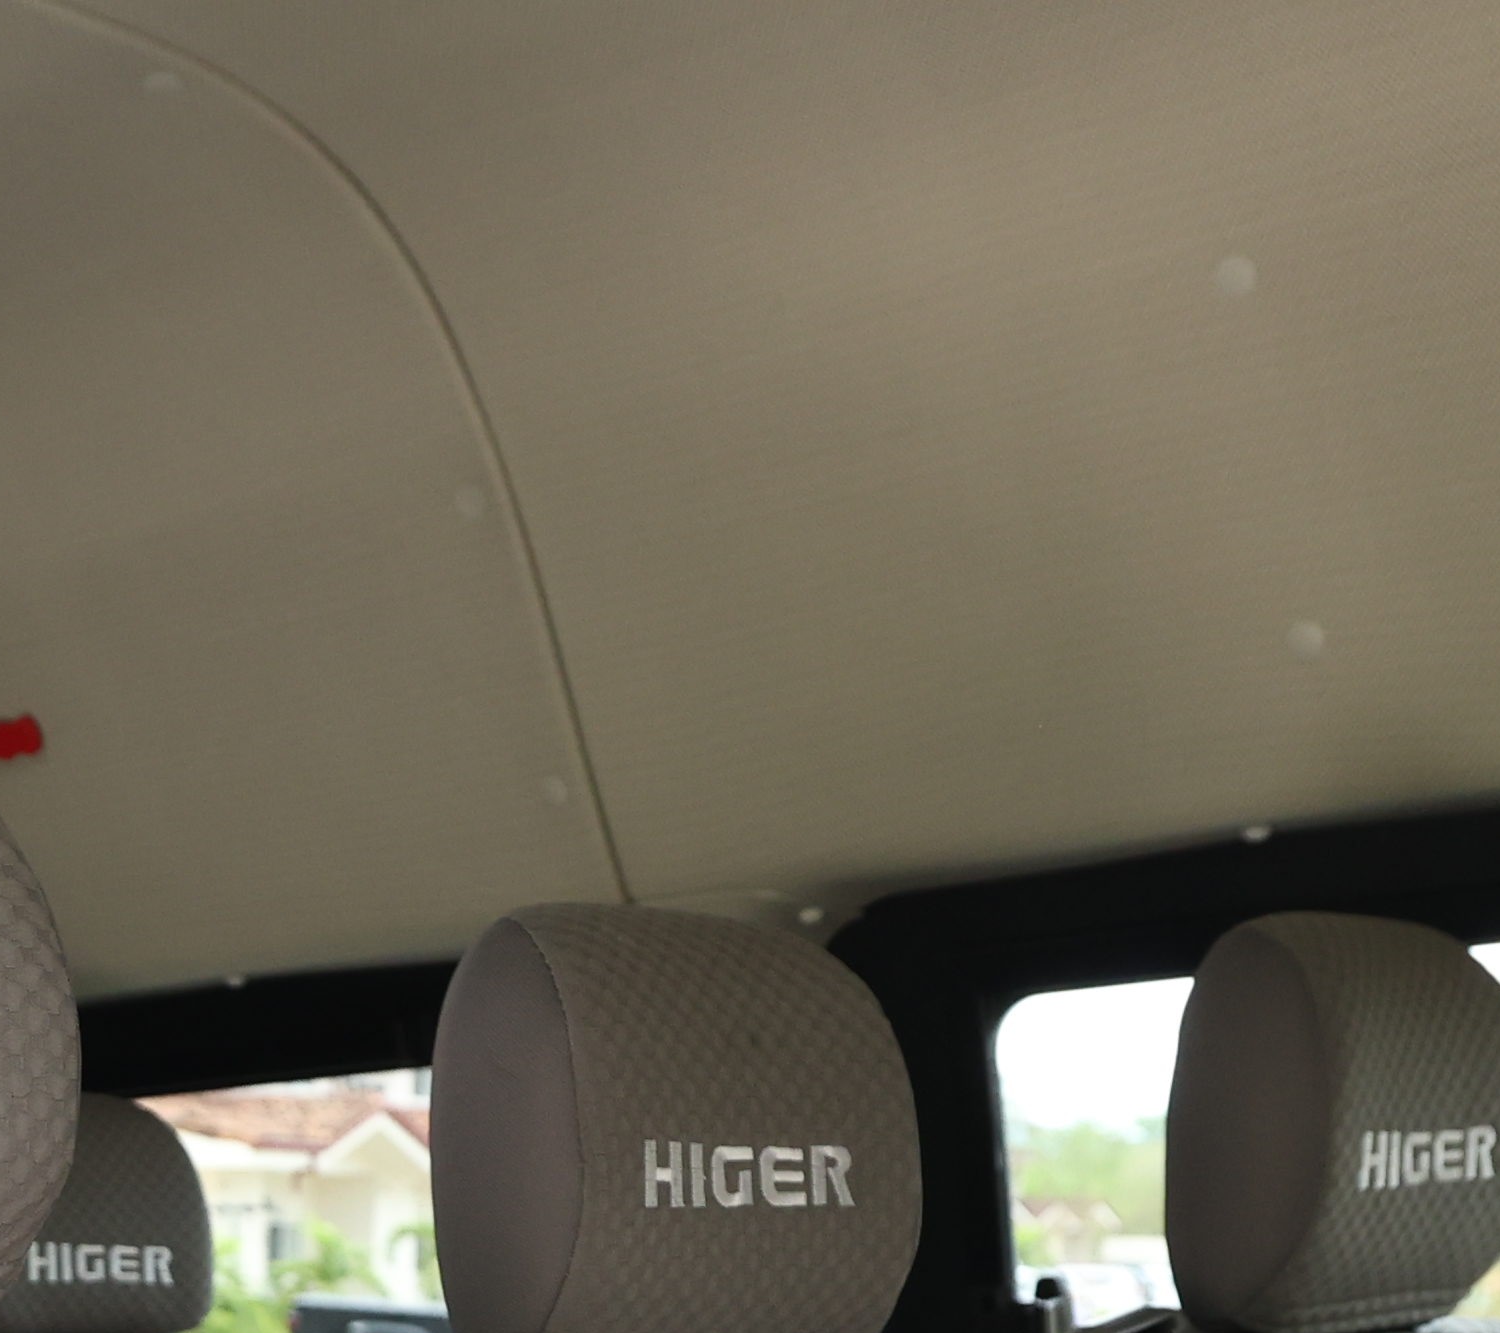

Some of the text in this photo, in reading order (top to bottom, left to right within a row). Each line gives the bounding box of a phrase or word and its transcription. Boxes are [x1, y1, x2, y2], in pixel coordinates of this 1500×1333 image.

[645, 1139, 855, 1208] HIGER
[1359, 1125, 1498, 1191] HIGER
[28, 1241, 174, 1288] HIGER
